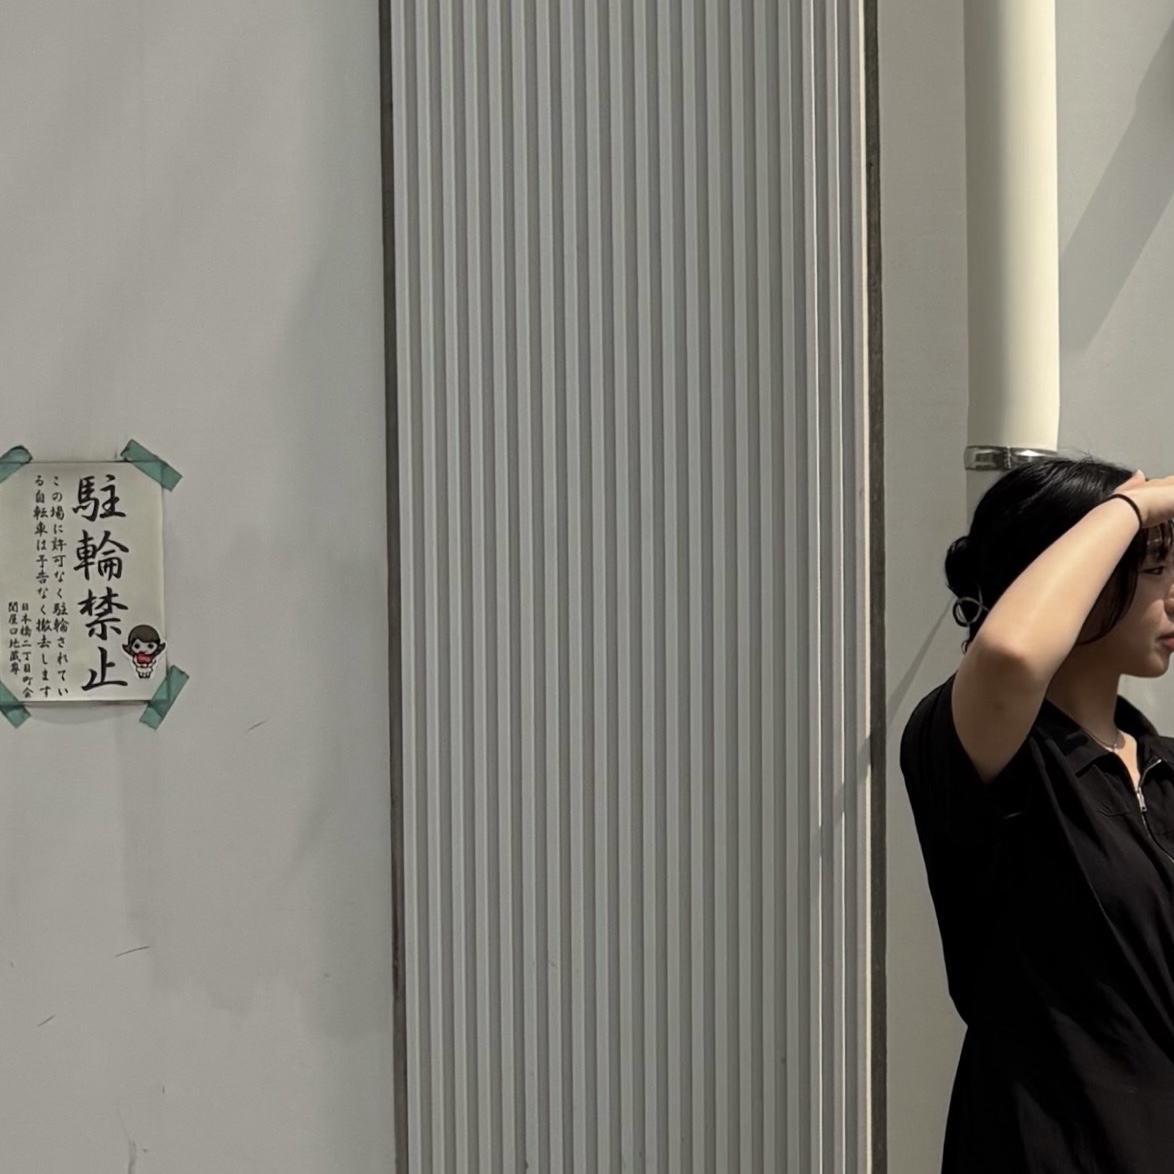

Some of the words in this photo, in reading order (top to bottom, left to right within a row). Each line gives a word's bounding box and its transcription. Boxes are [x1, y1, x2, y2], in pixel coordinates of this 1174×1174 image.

[33, 475, 52, 698] る自転車は予告なく撤去します
[50, 475, 69, 696] この場に許可なく駐輪されてい
[72, 474, 130, 692] 駐輪禁止
